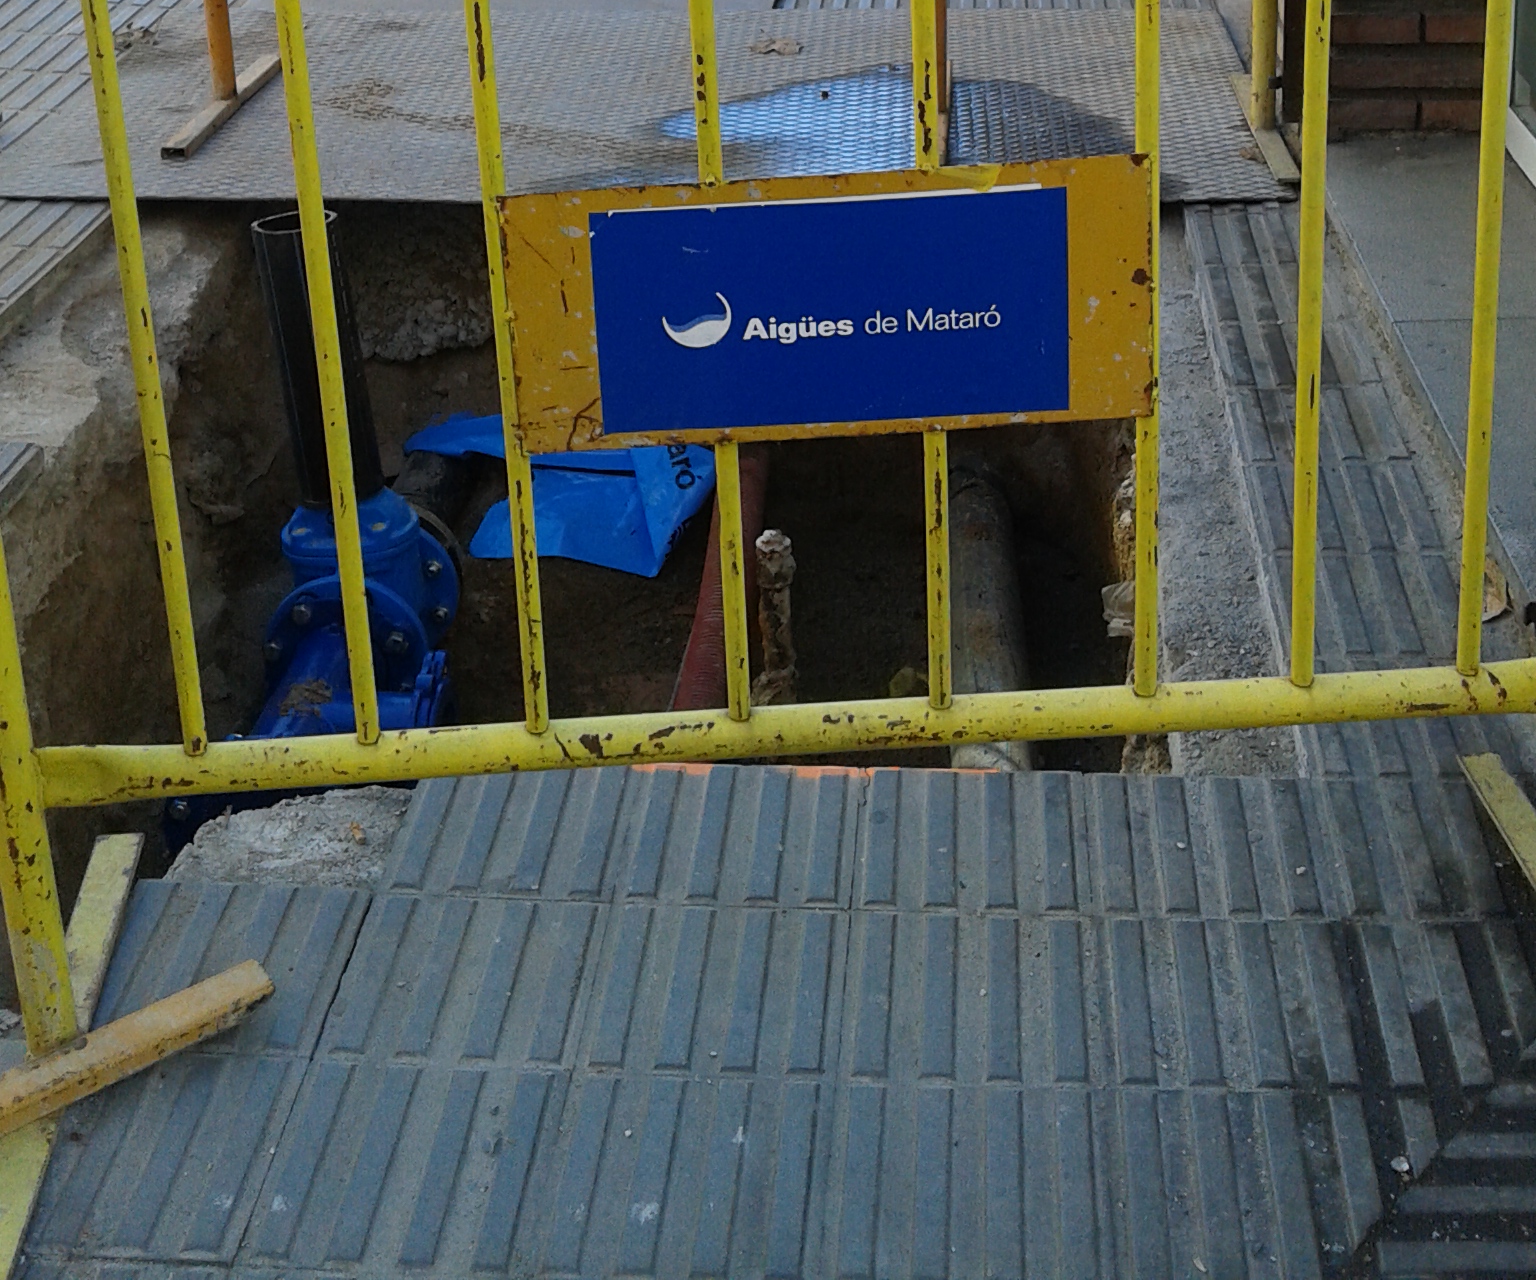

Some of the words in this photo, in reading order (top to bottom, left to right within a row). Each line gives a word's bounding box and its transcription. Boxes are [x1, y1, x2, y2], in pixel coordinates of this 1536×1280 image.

[742, 316, 854, 344] Aigües
[864, 310, 898, 335] de
[906, 304, 1001, 332] Mataró
